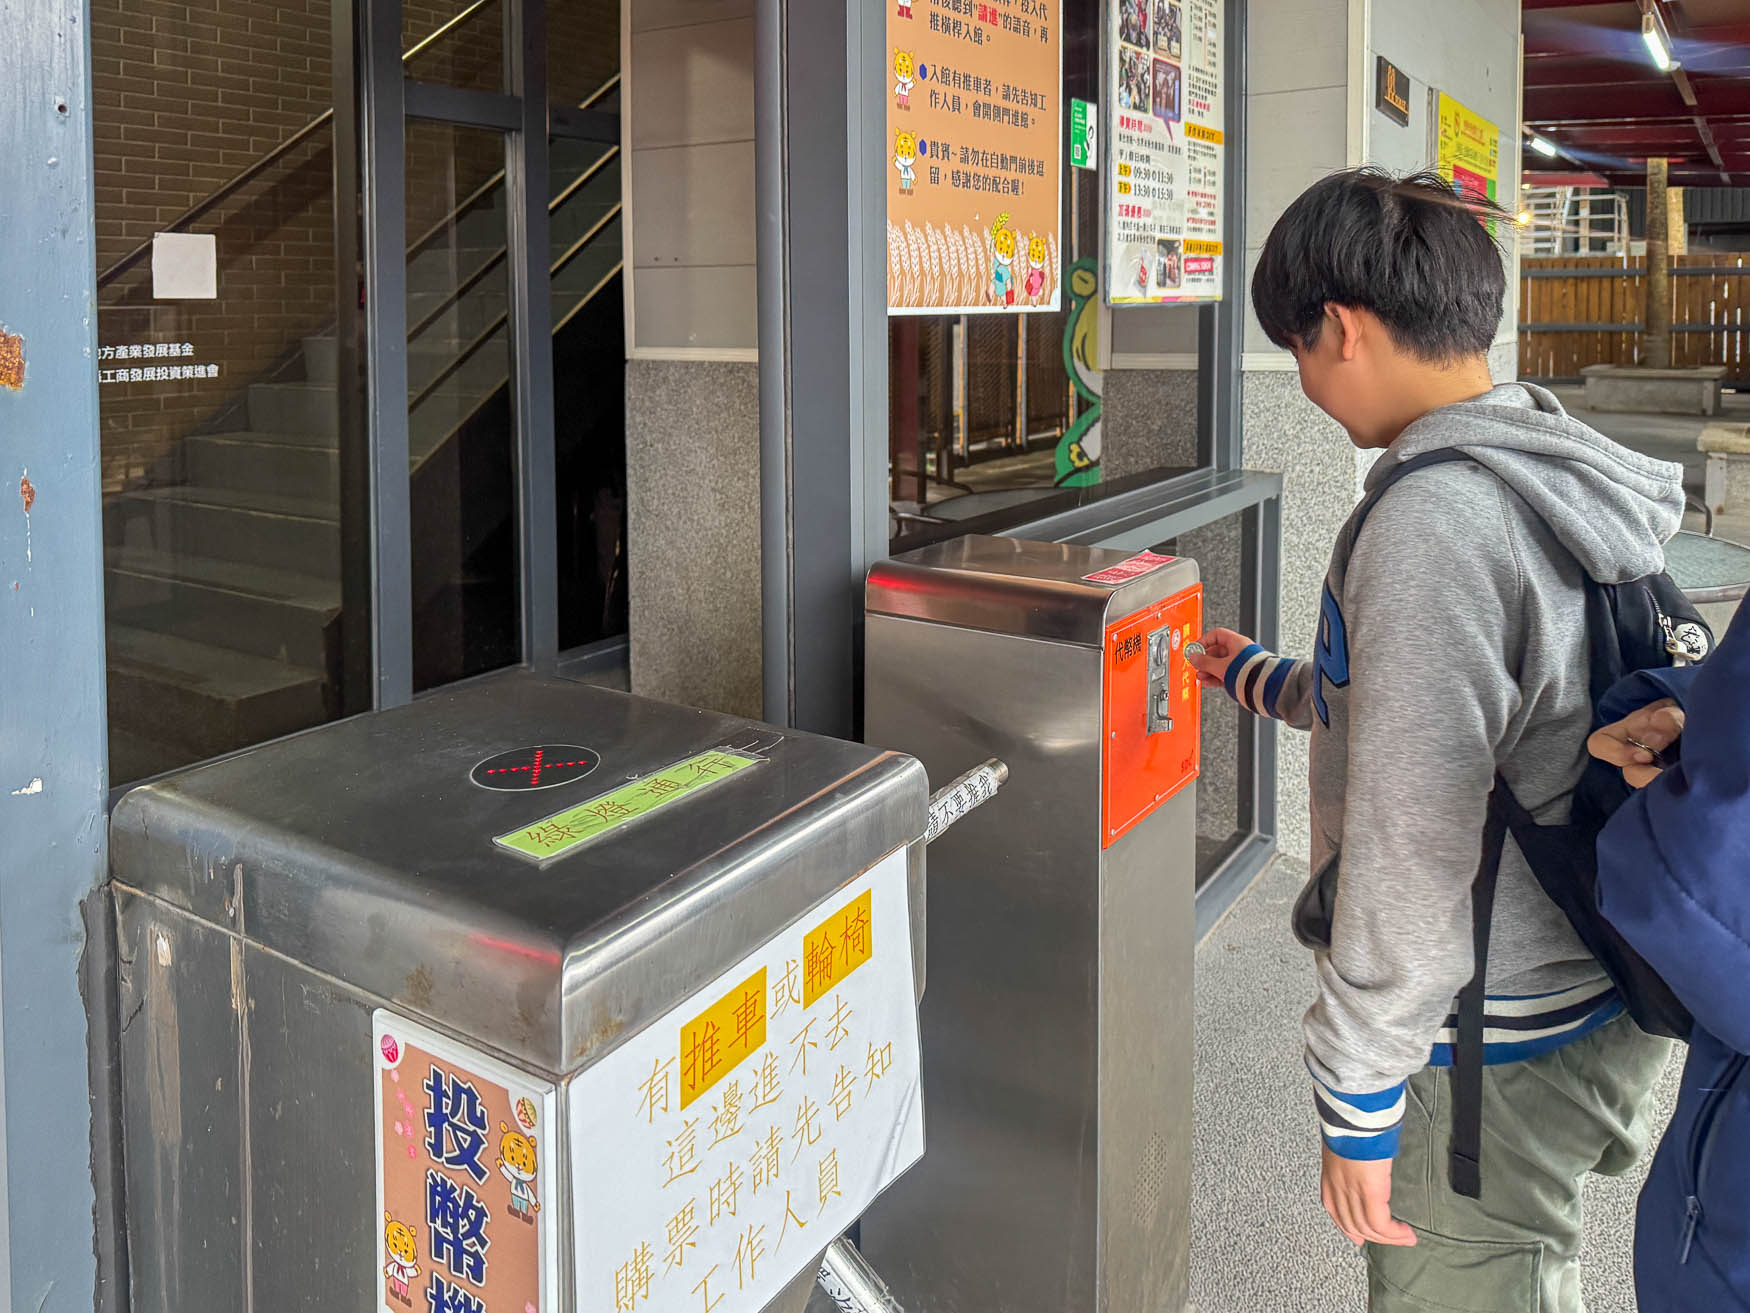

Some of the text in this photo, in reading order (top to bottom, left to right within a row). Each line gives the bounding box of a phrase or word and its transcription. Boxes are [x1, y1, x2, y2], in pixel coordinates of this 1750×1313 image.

[929, 64, 1047, 111] 入館有推車者，請先告知工
[929, 89, 1036, 128] 作人員，會開側門進館。
[1133, 165, 1150, 181] 09:30
[1157, 171, 1174, 185] 11:30
[1133, 183, 1150, 198] 13:30
[98, 342, 194, 359] 方產業發展基金
[98, 364, 219, 383] 工商發展投資策進會
[635, 905, 869, 1124] 有推車或輪椅
[661, 993, 854, 1189] 這邊進不去
[614, 1040, 894, 1313] 購票時請先告知
[690, 1147, 843, 1313] 工作人員
